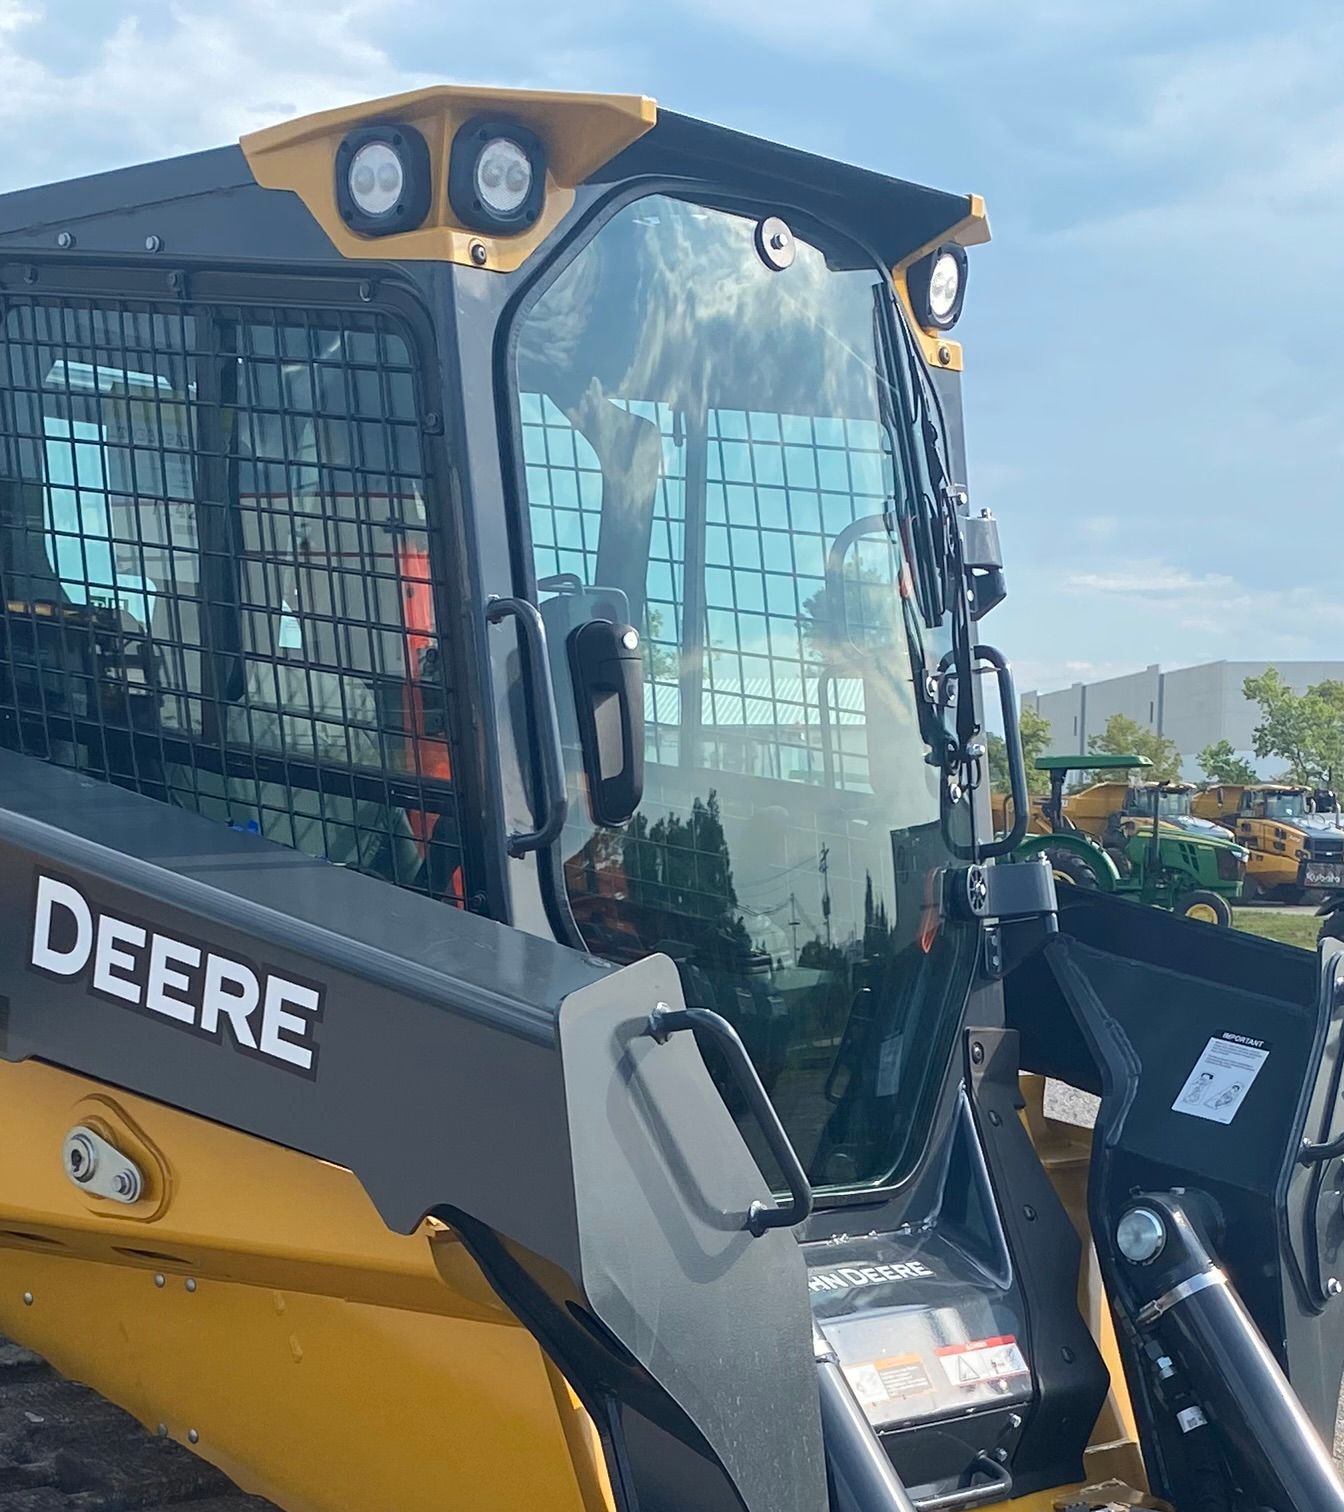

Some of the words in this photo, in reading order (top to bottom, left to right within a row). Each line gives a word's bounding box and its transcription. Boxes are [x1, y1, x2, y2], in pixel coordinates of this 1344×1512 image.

[31, 875, 320, 1070] DEERE
[1222, 1031, 1264, 1048] IMPORTANT
[808, 1273, 849, 1292] HN
[837, 1261, 935, 1287] DEERE
